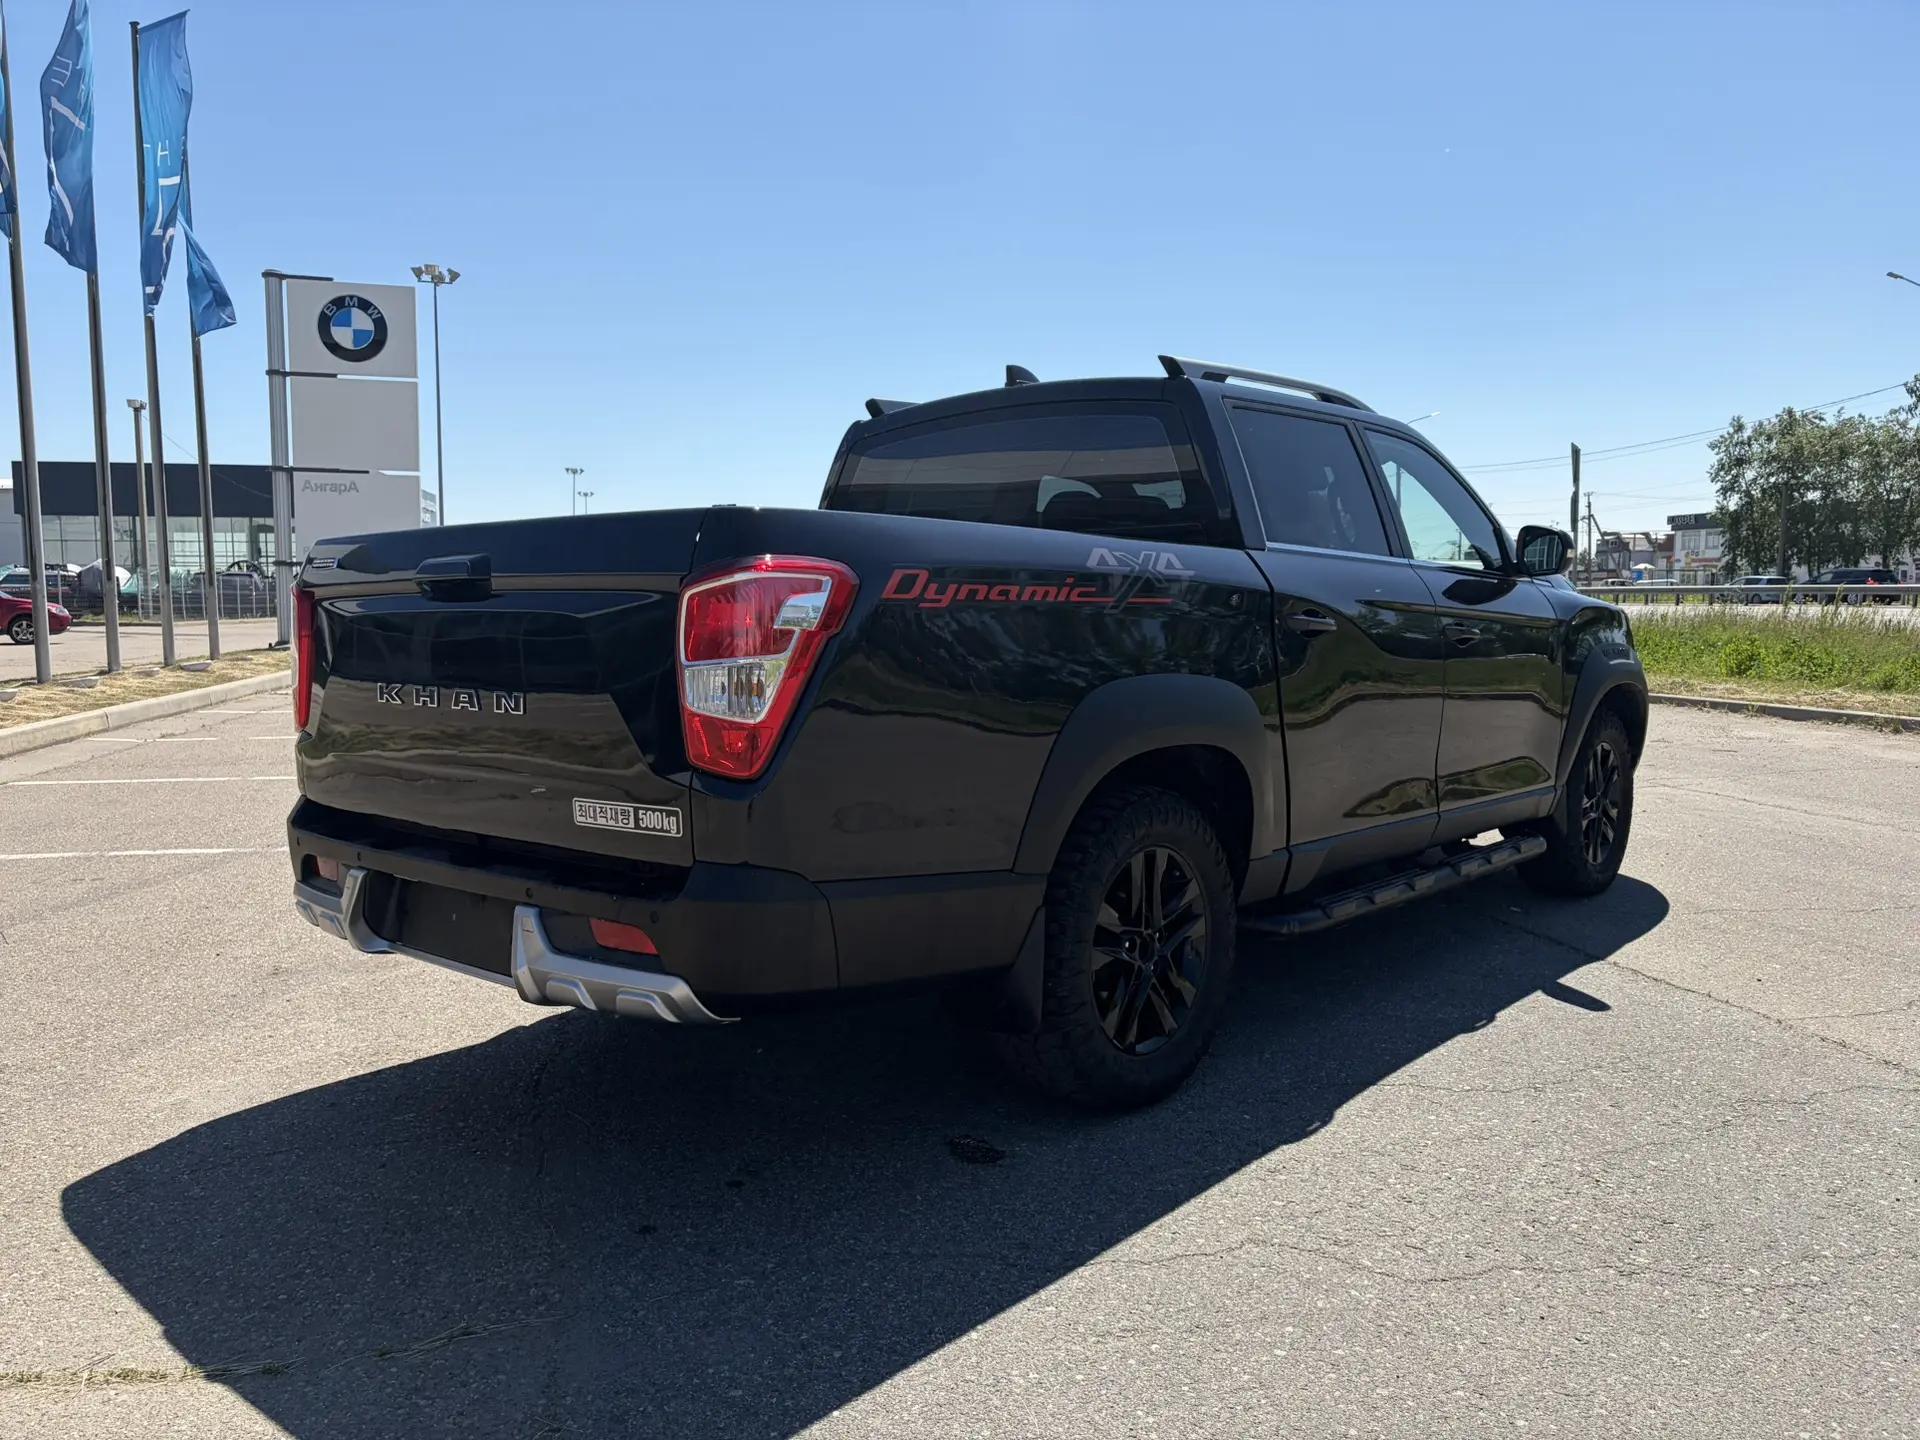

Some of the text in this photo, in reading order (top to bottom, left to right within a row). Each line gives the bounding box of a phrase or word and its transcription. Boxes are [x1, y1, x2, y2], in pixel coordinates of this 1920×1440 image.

[323, 296, 382, 320] BMW
[301, 479, 360, 495] АнгарА
[881, 568, 1174, 608] Dynamic
[377, 682, 525, 715] KHAN
[576, 802, 677, 834] 최대적재량 500kg
